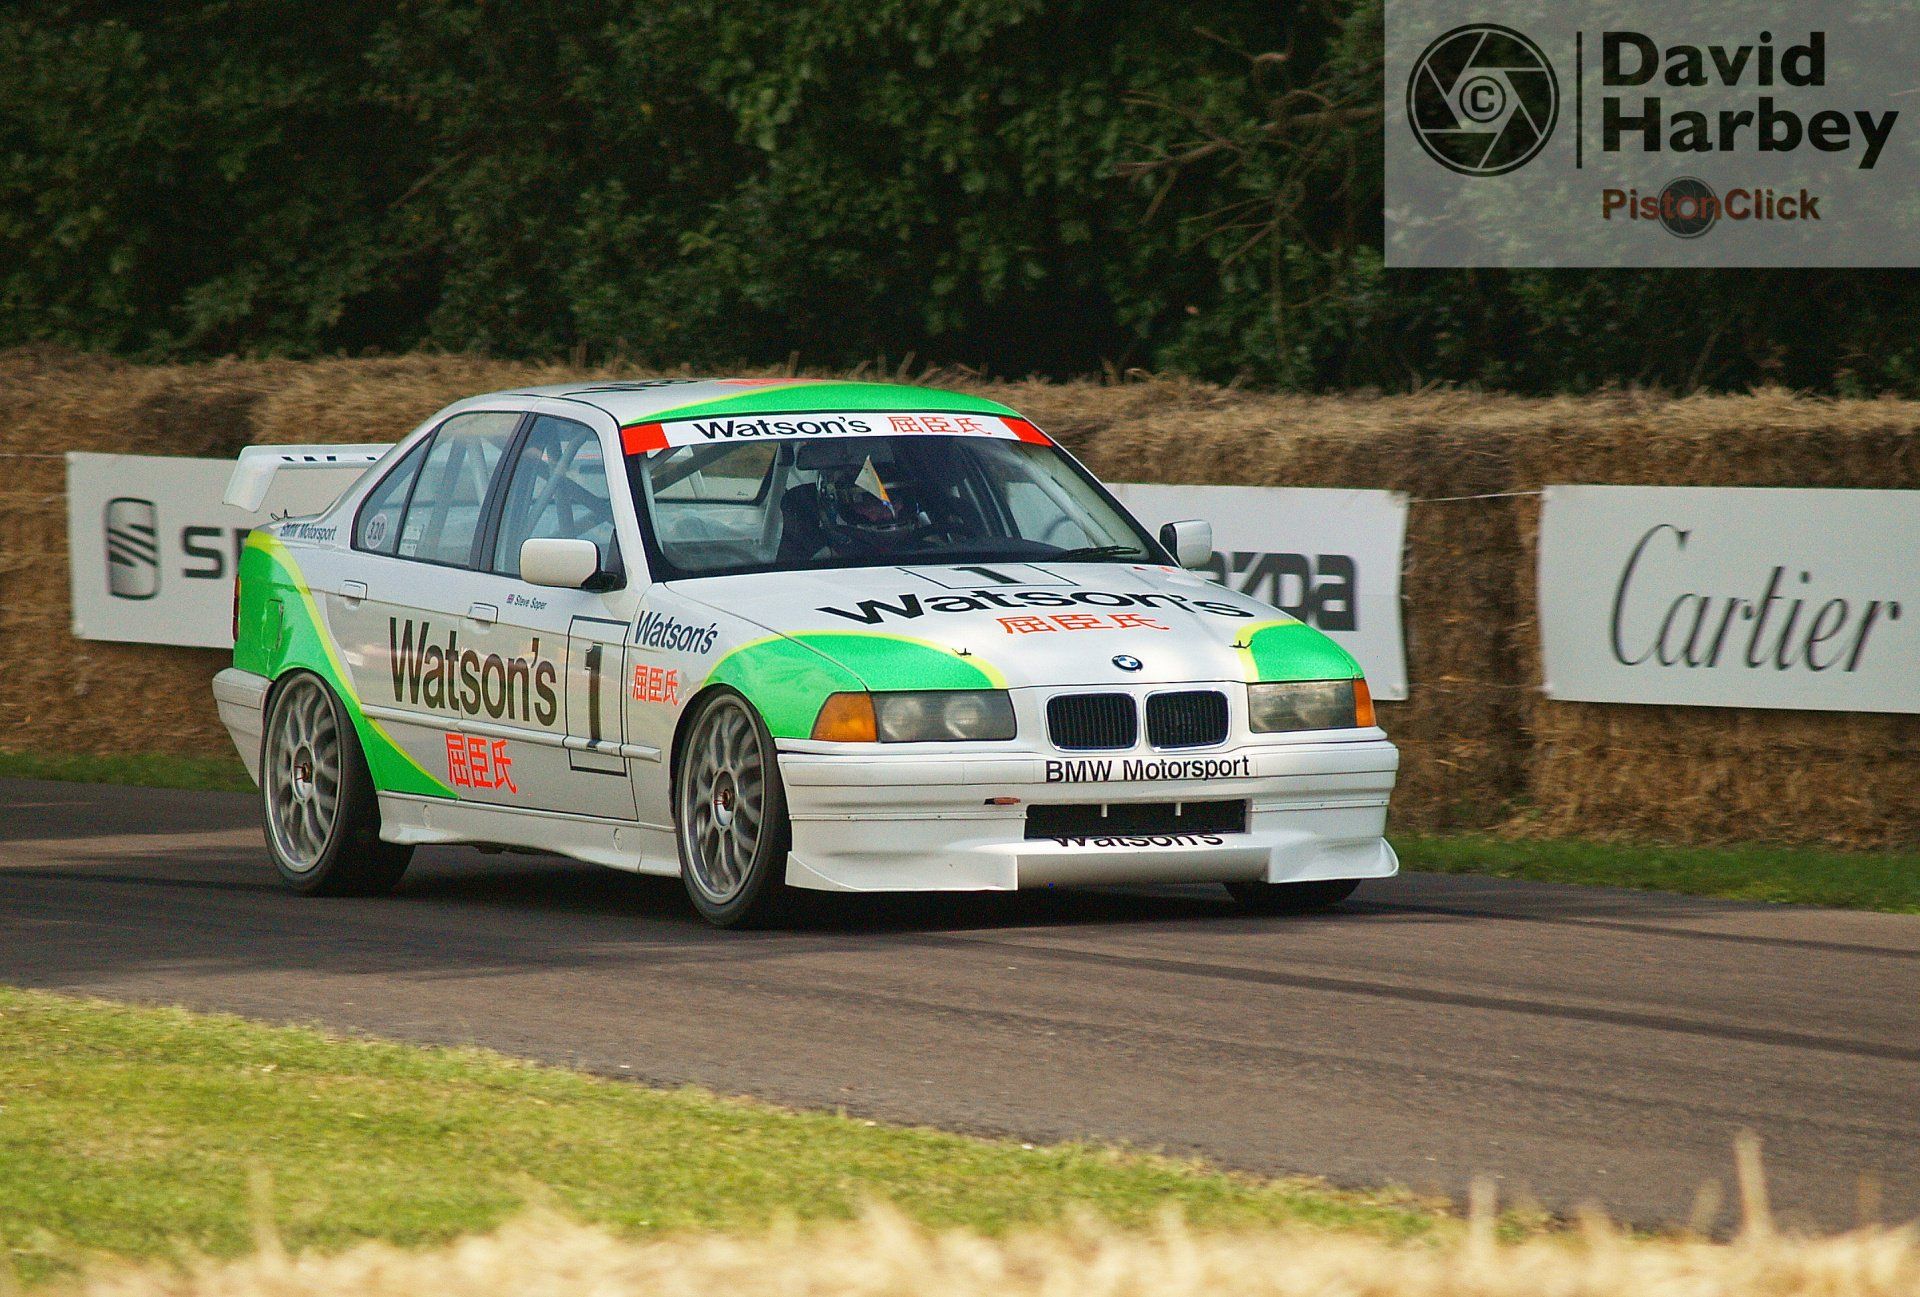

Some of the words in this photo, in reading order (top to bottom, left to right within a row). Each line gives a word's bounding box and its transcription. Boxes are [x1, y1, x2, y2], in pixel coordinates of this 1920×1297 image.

[694, 416, 872, 440] Watson's
[887, 415, 992, 435] 屈臣氏
[298, 523, 337, 543] Motorsport
[367, 521, 385, 541] 320
[815, 589, 1255, 625] Watson's
[1610, 523, 1901, 673] Cartier
[634, 610, 718, 655] Watson's
[995, 613, 1170, 635] 屈臣氏
[389, 616, 557, 727] Watson's
[632, 664, 679, 706] 屈臣氏
[584, 643, 603, 749] 1
[445, 732, 518, 794] 屈臣氏
[1046, 760, 1112, 783] BMW
[1123, 755, 1250, 781] Motorsport
[1052, 833, 1225, 847] Watsons
